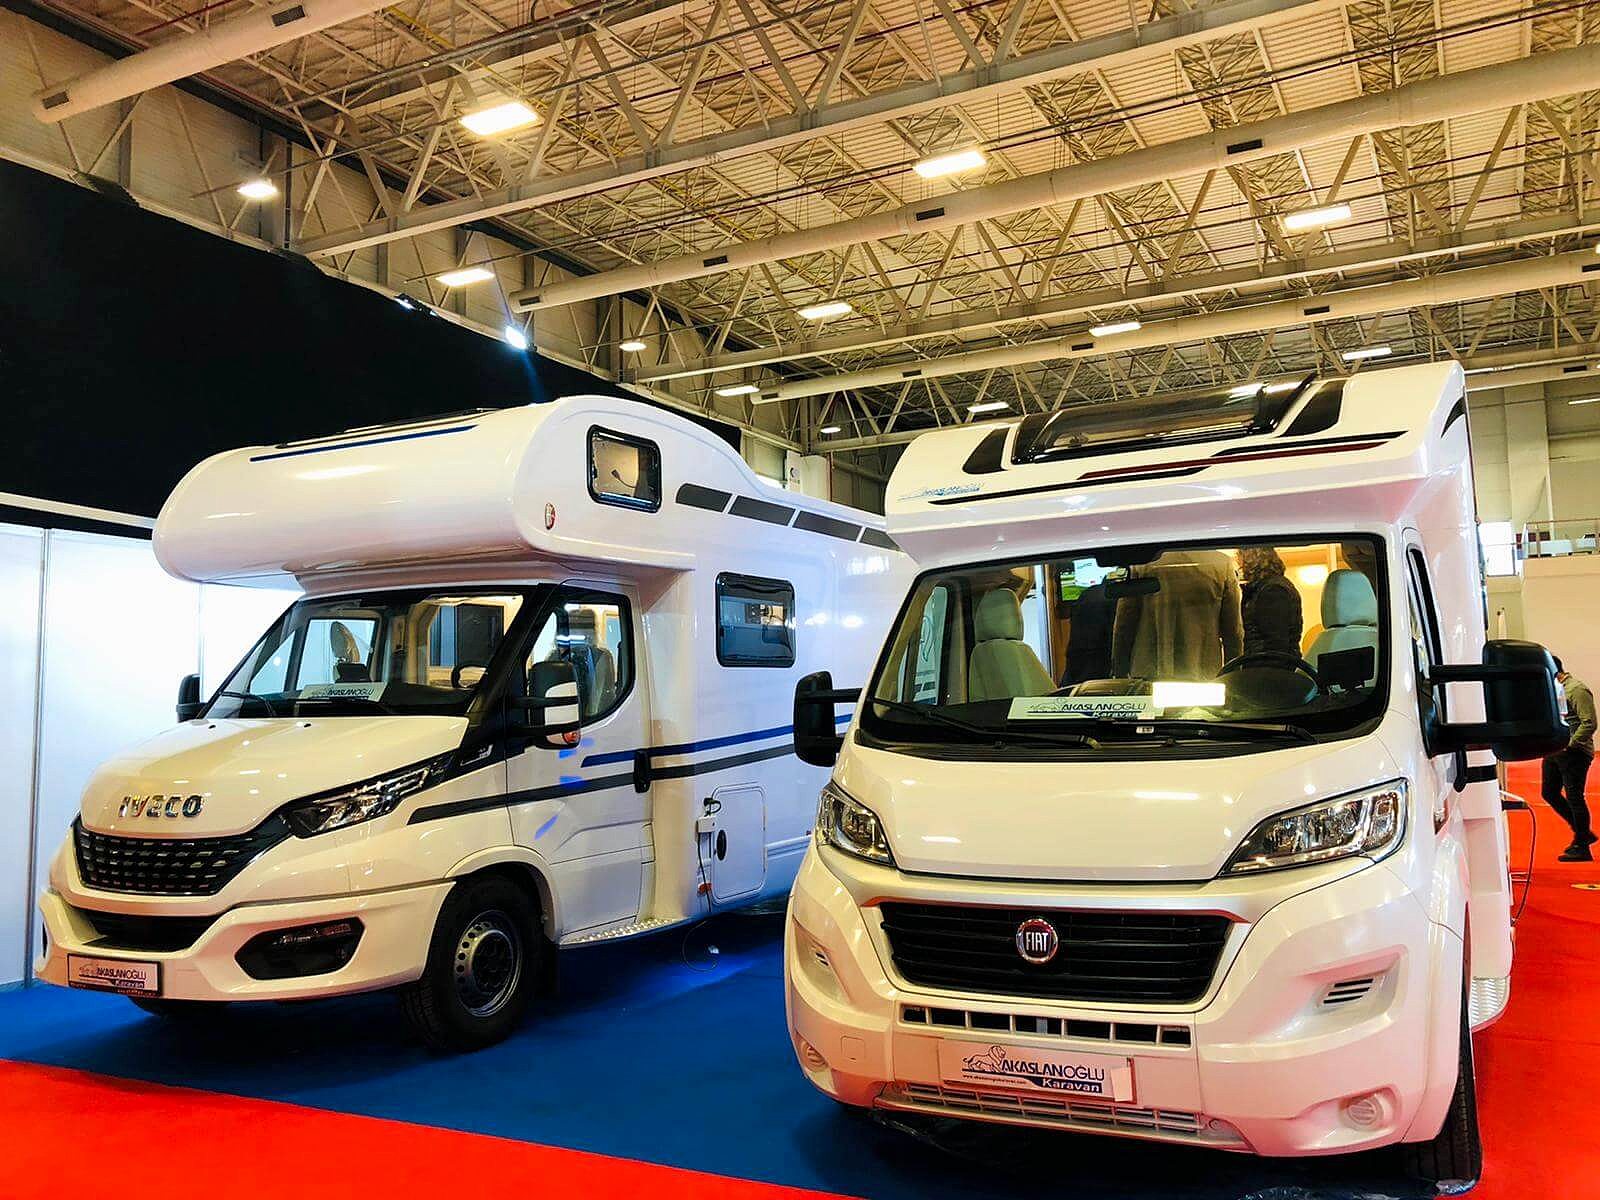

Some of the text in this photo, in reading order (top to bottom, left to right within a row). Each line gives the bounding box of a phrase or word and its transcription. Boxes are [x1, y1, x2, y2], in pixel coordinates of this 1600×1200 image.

[118, 795, 203, 817] IVECO
[1025, 931, 1049, 952] FIAT
[1042, 1078, 1100, 1092] Karavan
